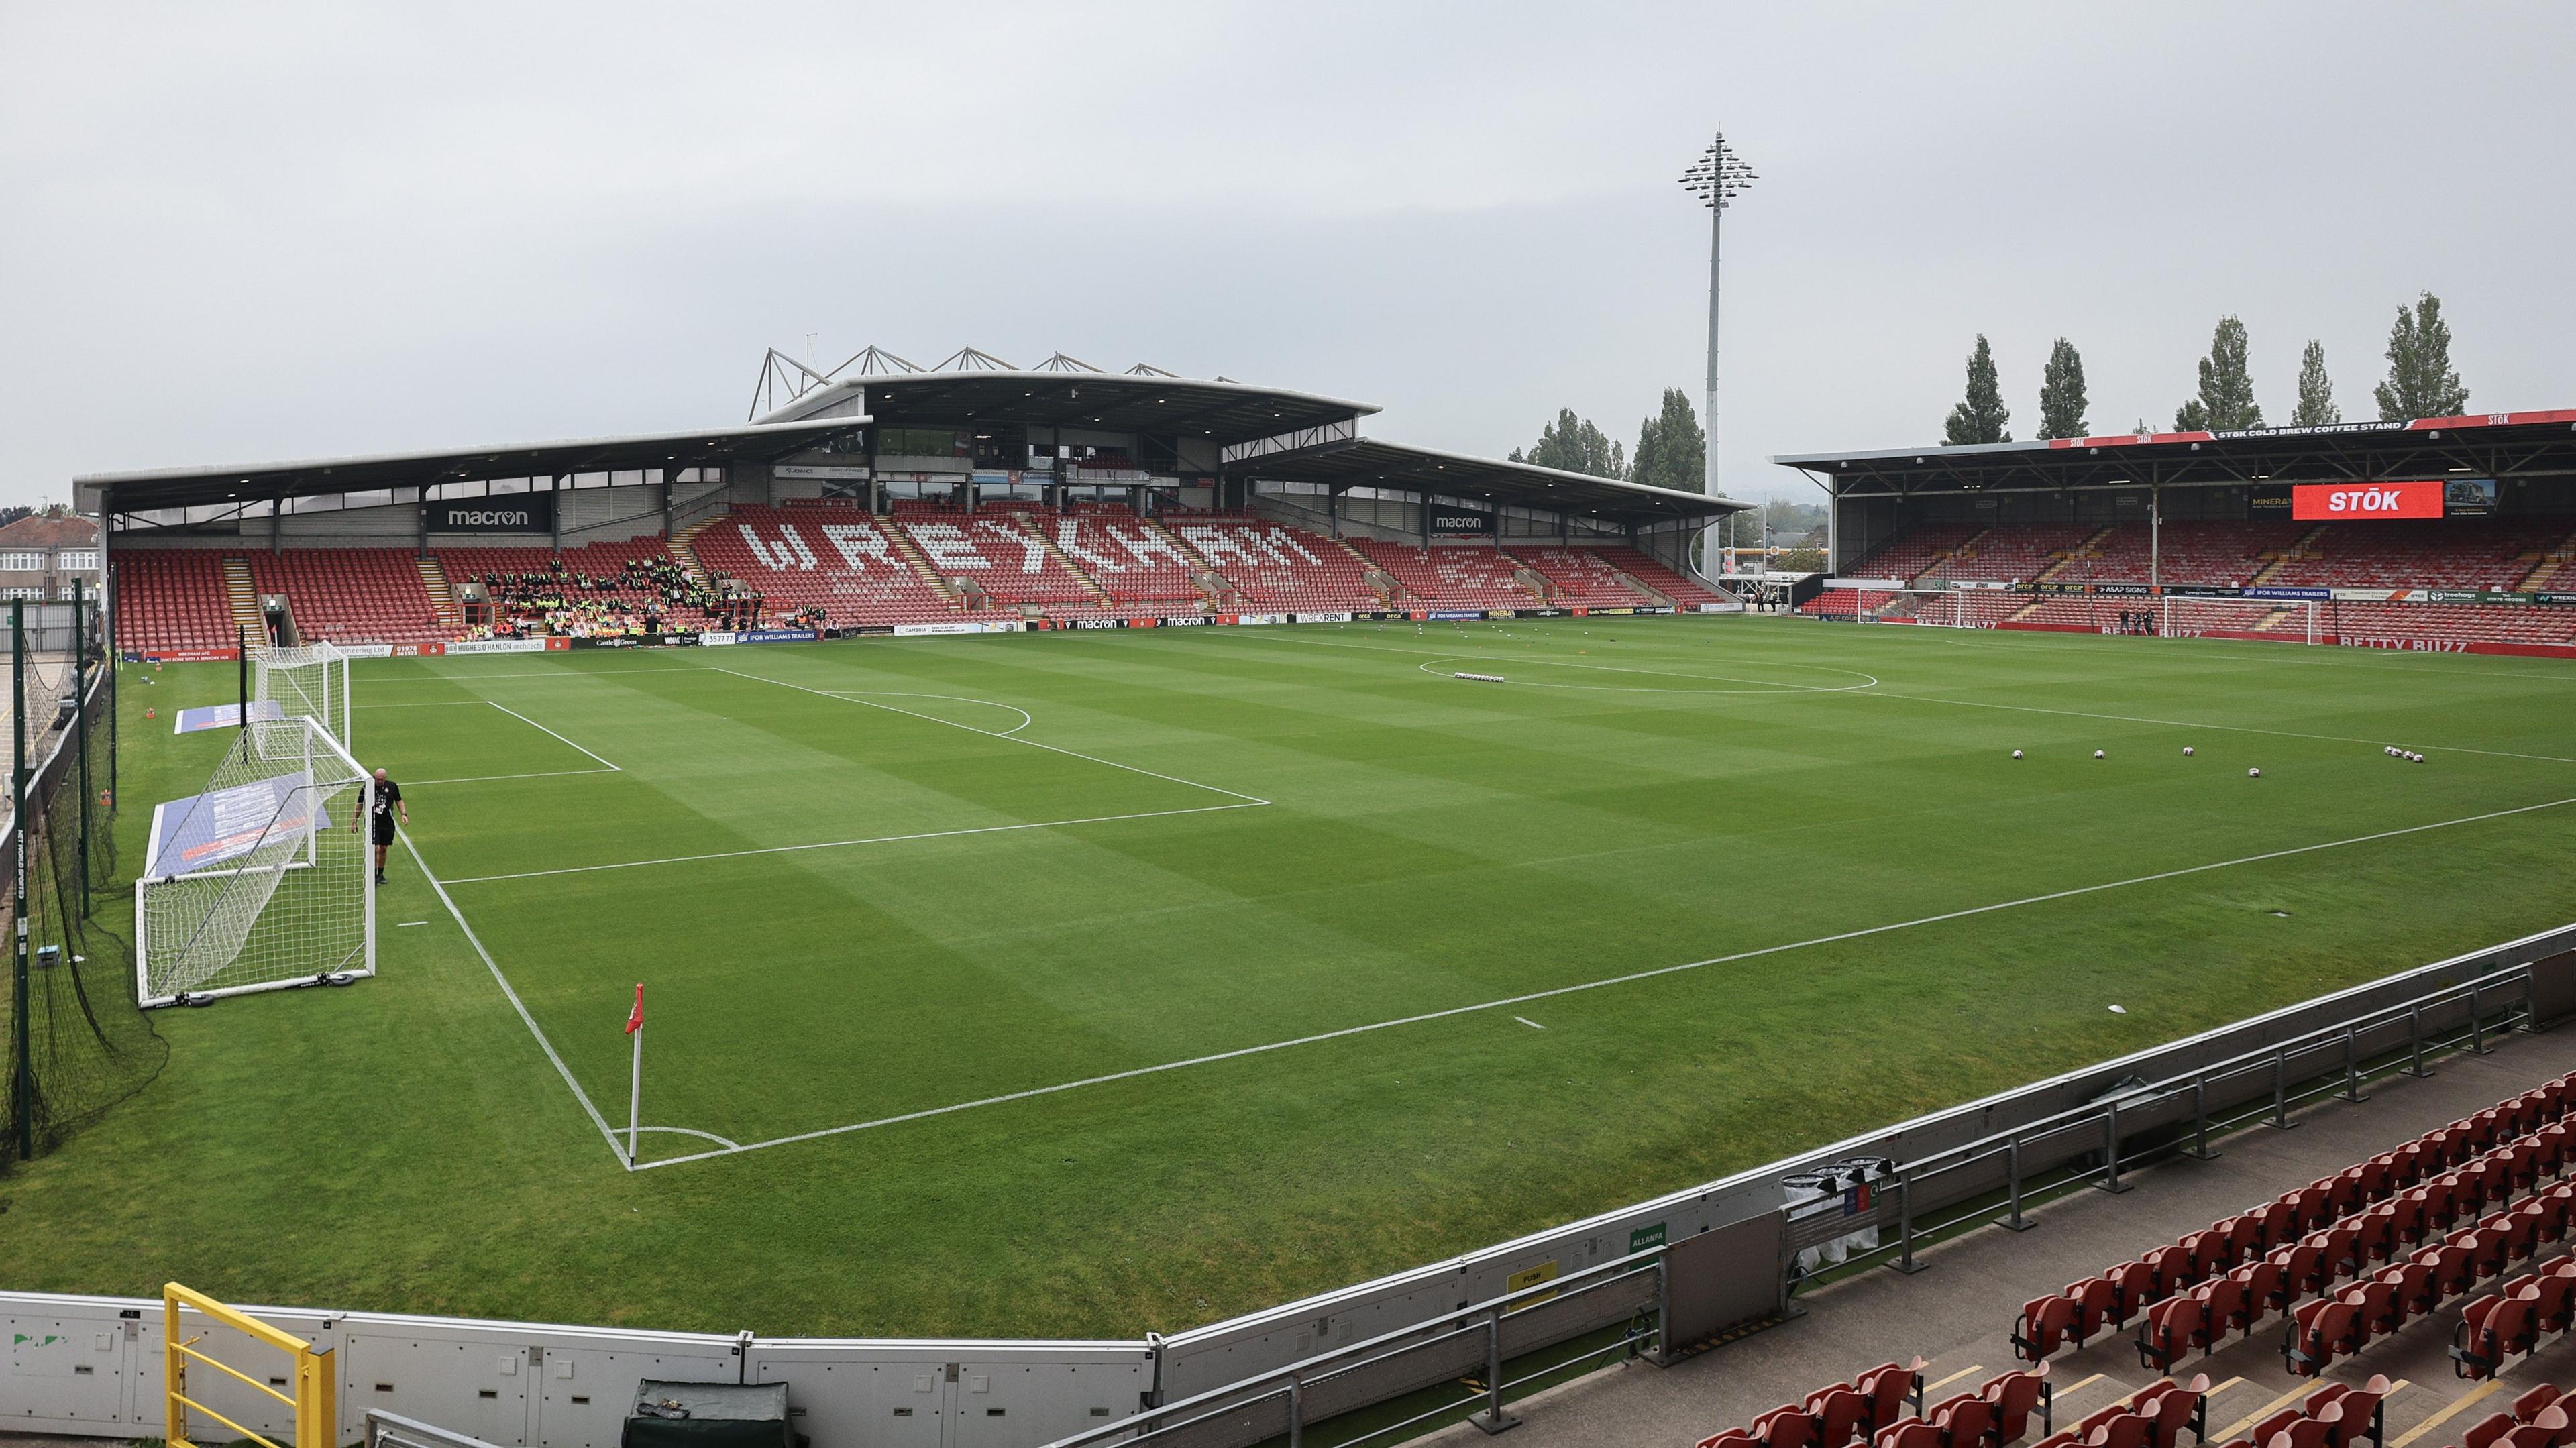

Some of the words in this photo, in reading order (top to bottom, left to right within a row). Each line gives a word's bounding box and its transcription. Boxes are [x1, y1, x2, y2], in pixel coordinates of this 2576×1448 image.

[2249, 429, 2277, 437] COLD
[2279, 427, 2312, 436] BREW
[2314, 423, 2359, 433] COFFEE
[2360, 422, 2402, 431] STAND
[449, 510, 529, 526] macron
[1436, 517, 1481, 528] macron
[2125, 586, 2147, 594] SIGNS
[2257, 588, 2271, 596] IFOR
[2271, 588, 2301, 596] WILLIAMS
[2301, 590, 2328, 598] TRAILERS
[1167, 616, 1205, 626] macron
[1300, 612, 1345, 622] WREXRENT
[1077, 618, 1117, 630] macron
[2339, 636, 2406, 650] BETTY
[1632, 1232, 1664, 1247] ALLANFA
[1523, 1272, 1542, 1284] PUSH
